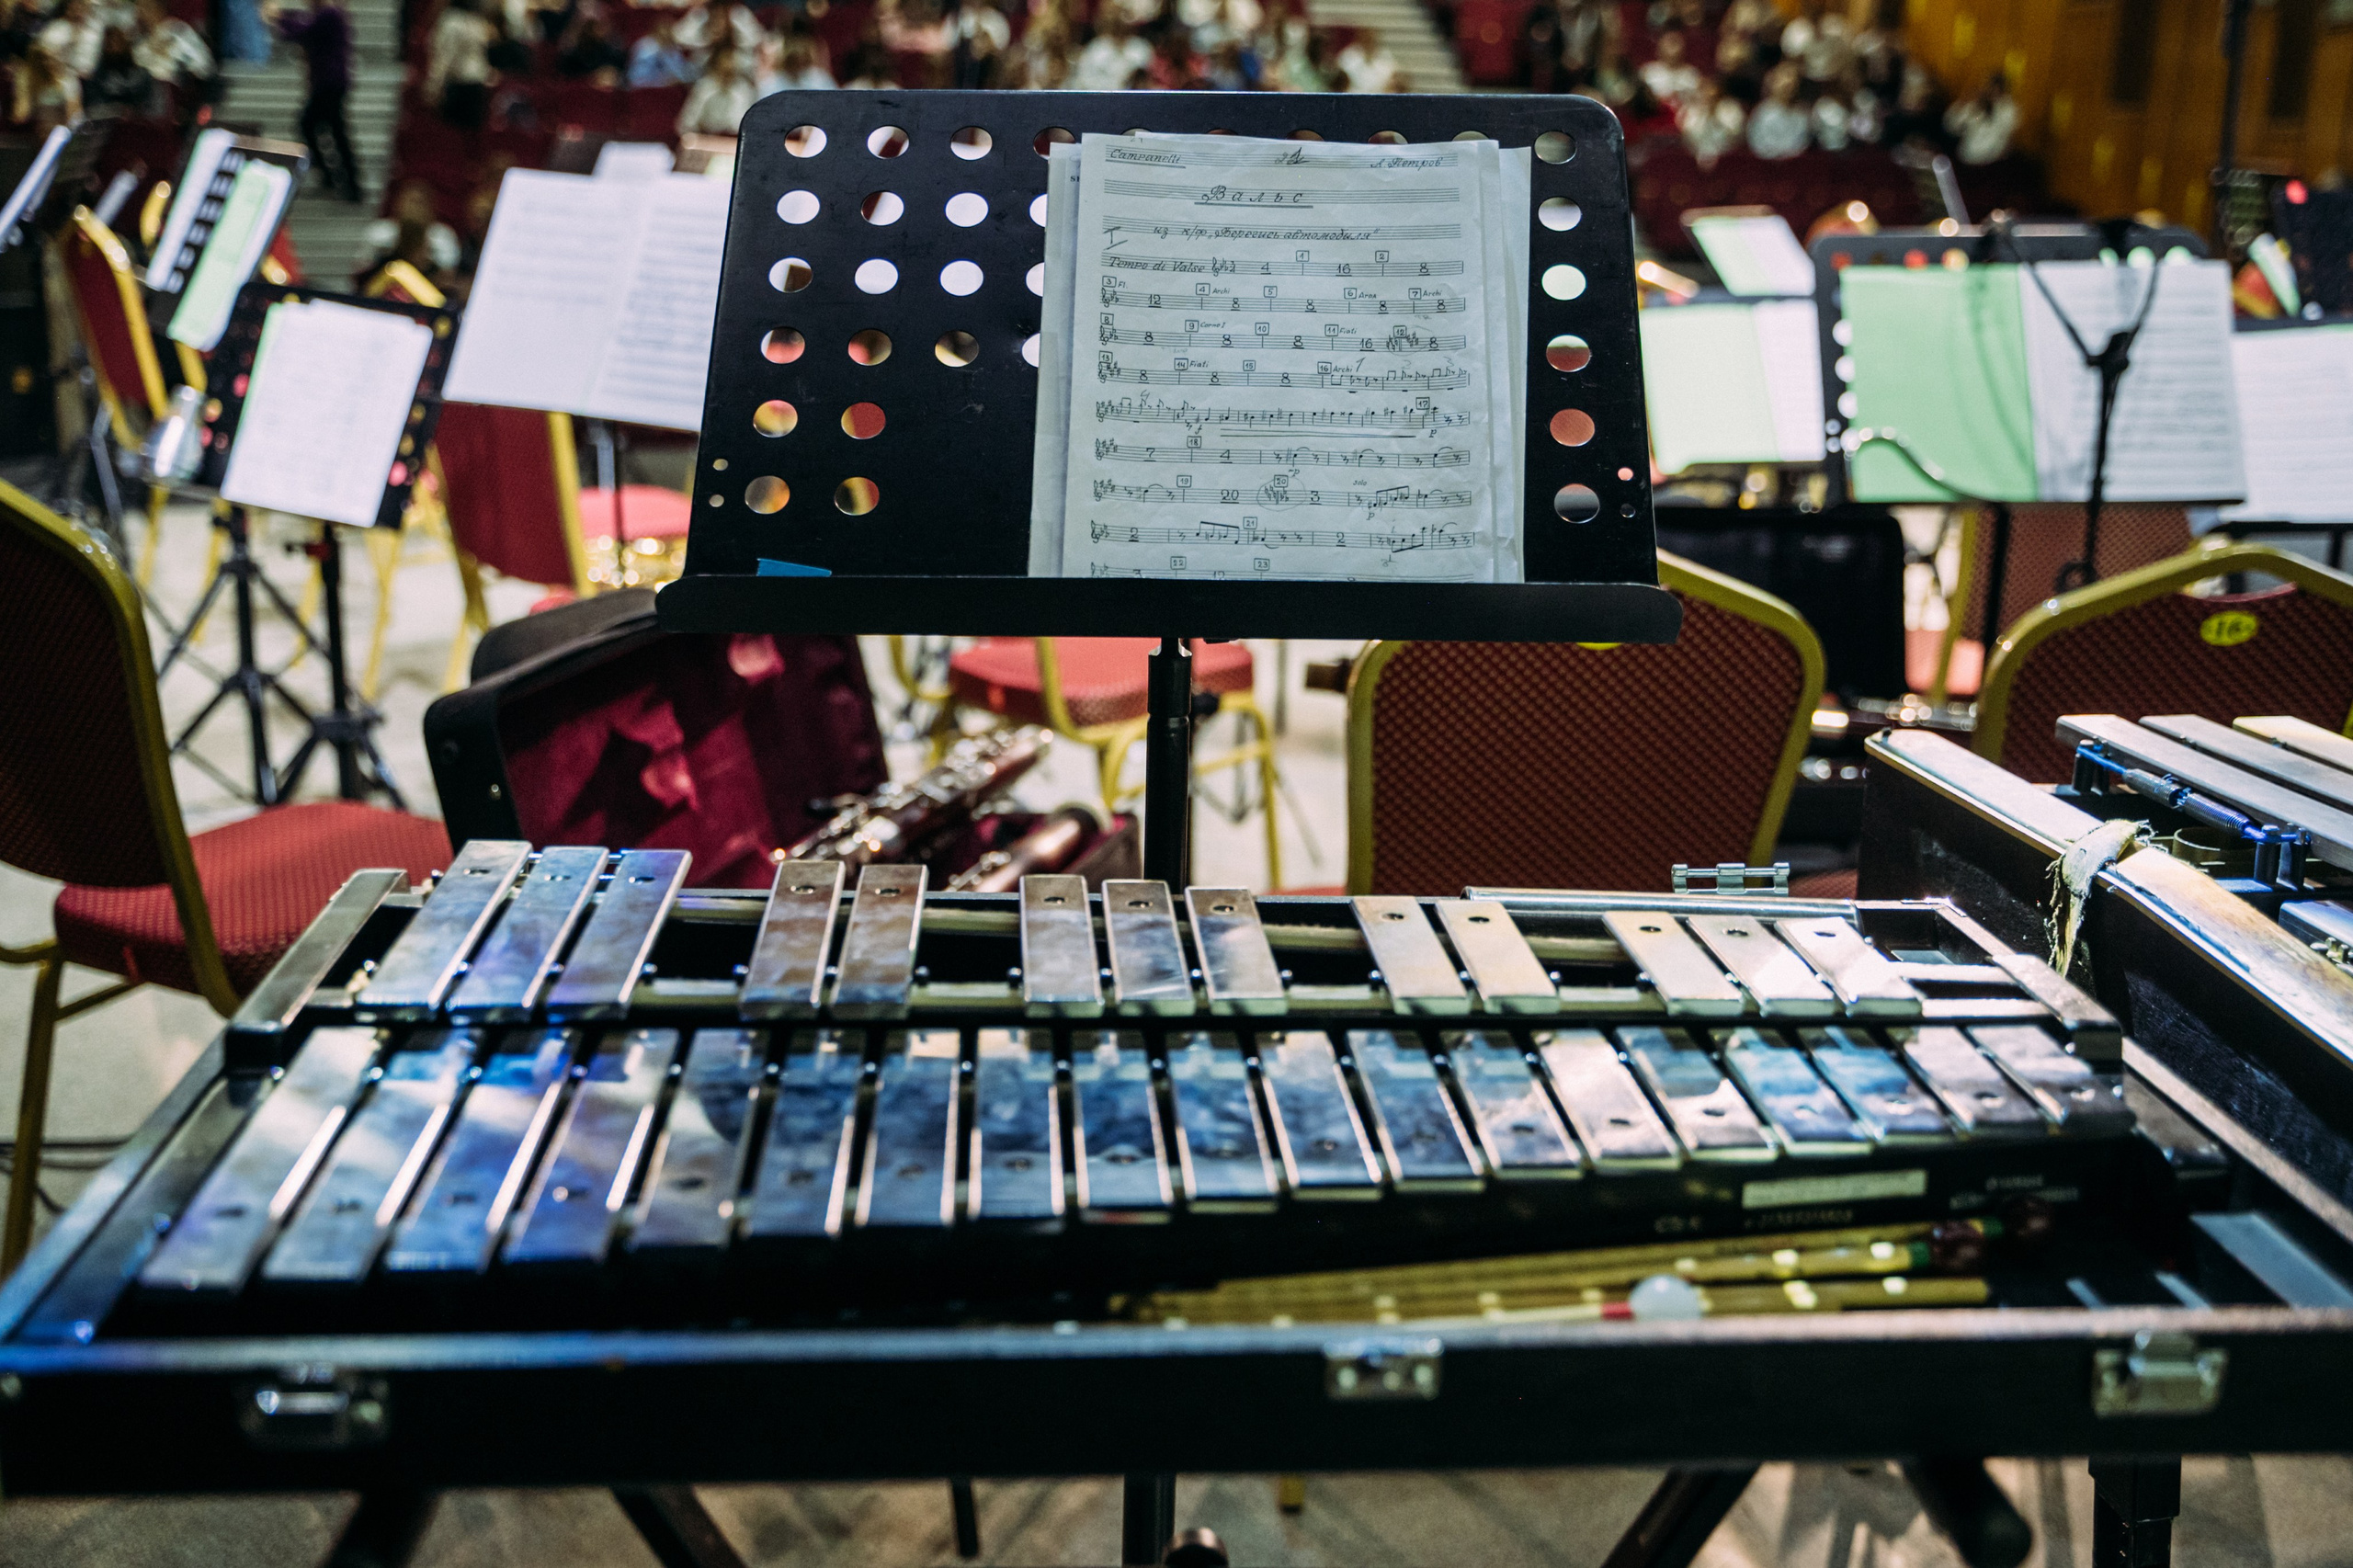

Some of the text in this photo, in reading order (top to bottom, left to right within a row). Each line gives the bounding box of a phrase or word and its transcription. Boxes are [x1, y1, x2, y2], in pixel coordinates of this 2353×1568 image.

[1110, 148, 1181, 164] Campanelli
[1388, 156, 1444, 172] Петров
[1108, 256, 1205, 273] Tempo di Valse
[1260, 262, 1269, 272] 4
[1336, 264, 1351, 274] 16
[1420, 263, 1428, 273] 8
[1148, 294, 1161, 305] 12
[1232, 298, 1240, 309] 8
[1306, 299, 1315, 311] 8
[1437, 299, 1446, 310] 8
[1379, 301, 1387, 312] 8
[1144, 331, 1154, 343] 8
[1222, 335, 1232, 346] 8
[1293, 335, 1303, 347] 8
[1429, 336, 1438, 348] 8
[1359, 338, 1373, 349] 16
[1333, 365, 1353, 373] Archi
[1139, 369, 1148, 381] 8
[1211, 371, 1219, 383] 8
[1280, 372, 1290, 384] 8
[1146, 448, 1155, 458] 7
[1220, 449, 1230, 460] 4
[1221, 489, 1239, 500] 20
[1310, 490, 1321, 502] 3
[1130, 527, 1139, 539] 2
[1336, 532, 1346, 543] 2
